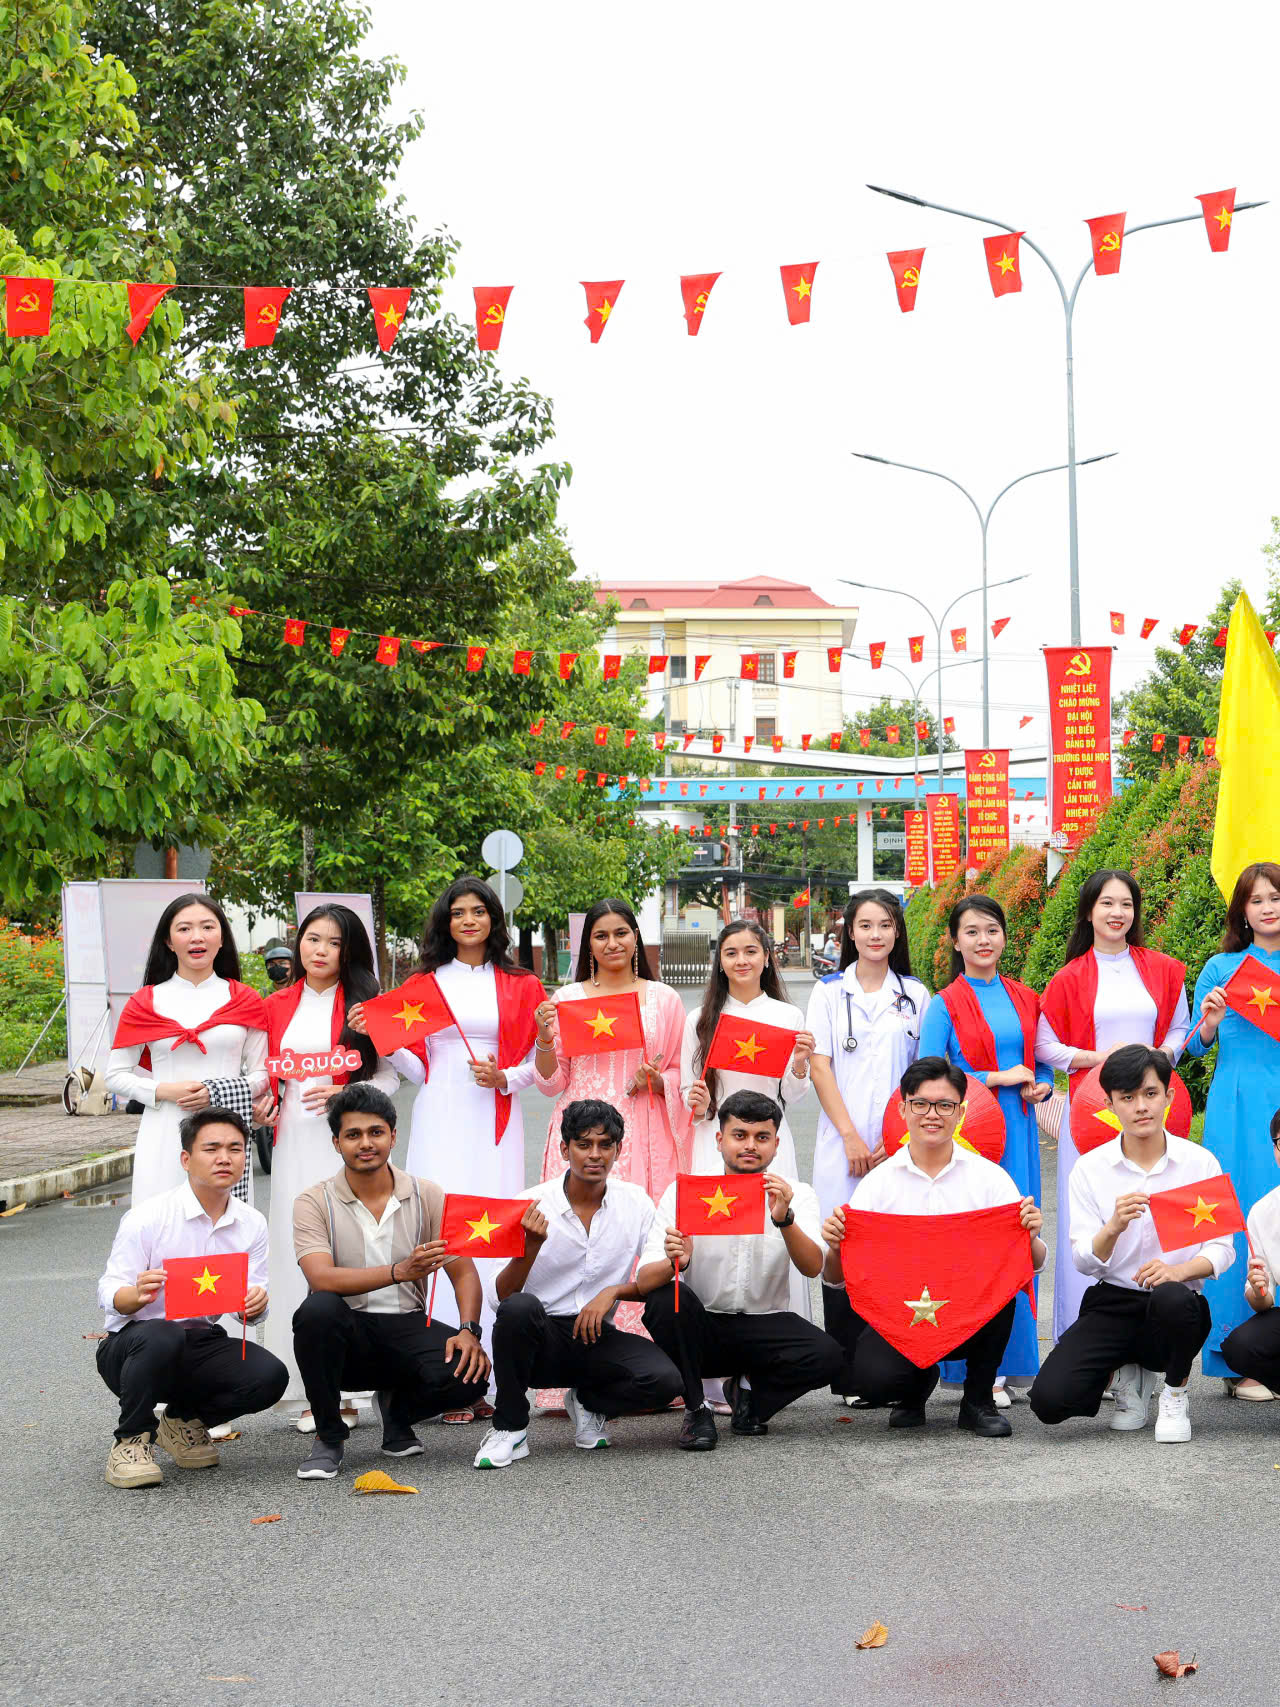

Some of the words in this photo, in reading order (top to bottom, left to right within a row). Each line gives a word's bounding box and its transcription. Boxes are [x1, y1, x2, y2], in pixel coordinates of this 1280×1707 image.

[1061, 682, 1080, 695] NHIỆT
[1082, 682, 1097, 695] LIỆT
[1058, 697, 1077, 708] CHÀO
[1079, 696, 1101, 707] MỪNG
[1067, 712, 1079, 723] ĐẠI
[1080, 710, 1093, 722] HỘI
[1065, 726, 1077, 736] ĐẠI
[1078, 722, 1095, 734] BIỂU
[1065, 737, 1084, 748] ĐẢNG
[1085, 738, 1096, 749] BỘ
[1081, 753, 1094, 763] ĐẠI
[1095, 752, 1110, 763] HỌC
[1069, 767, 1074, 776] Y
[1075, 766, 1094, 777] DƯỢC
[1083, 780, 1097, 790] THƠ
[1061, 823, 1079, 831] 2025
[883, 837, 904, 845] ĐỊNH
[268, 1052, 295, 1073] TỔ
[301, 1049, 358, 1071] QUỐC
